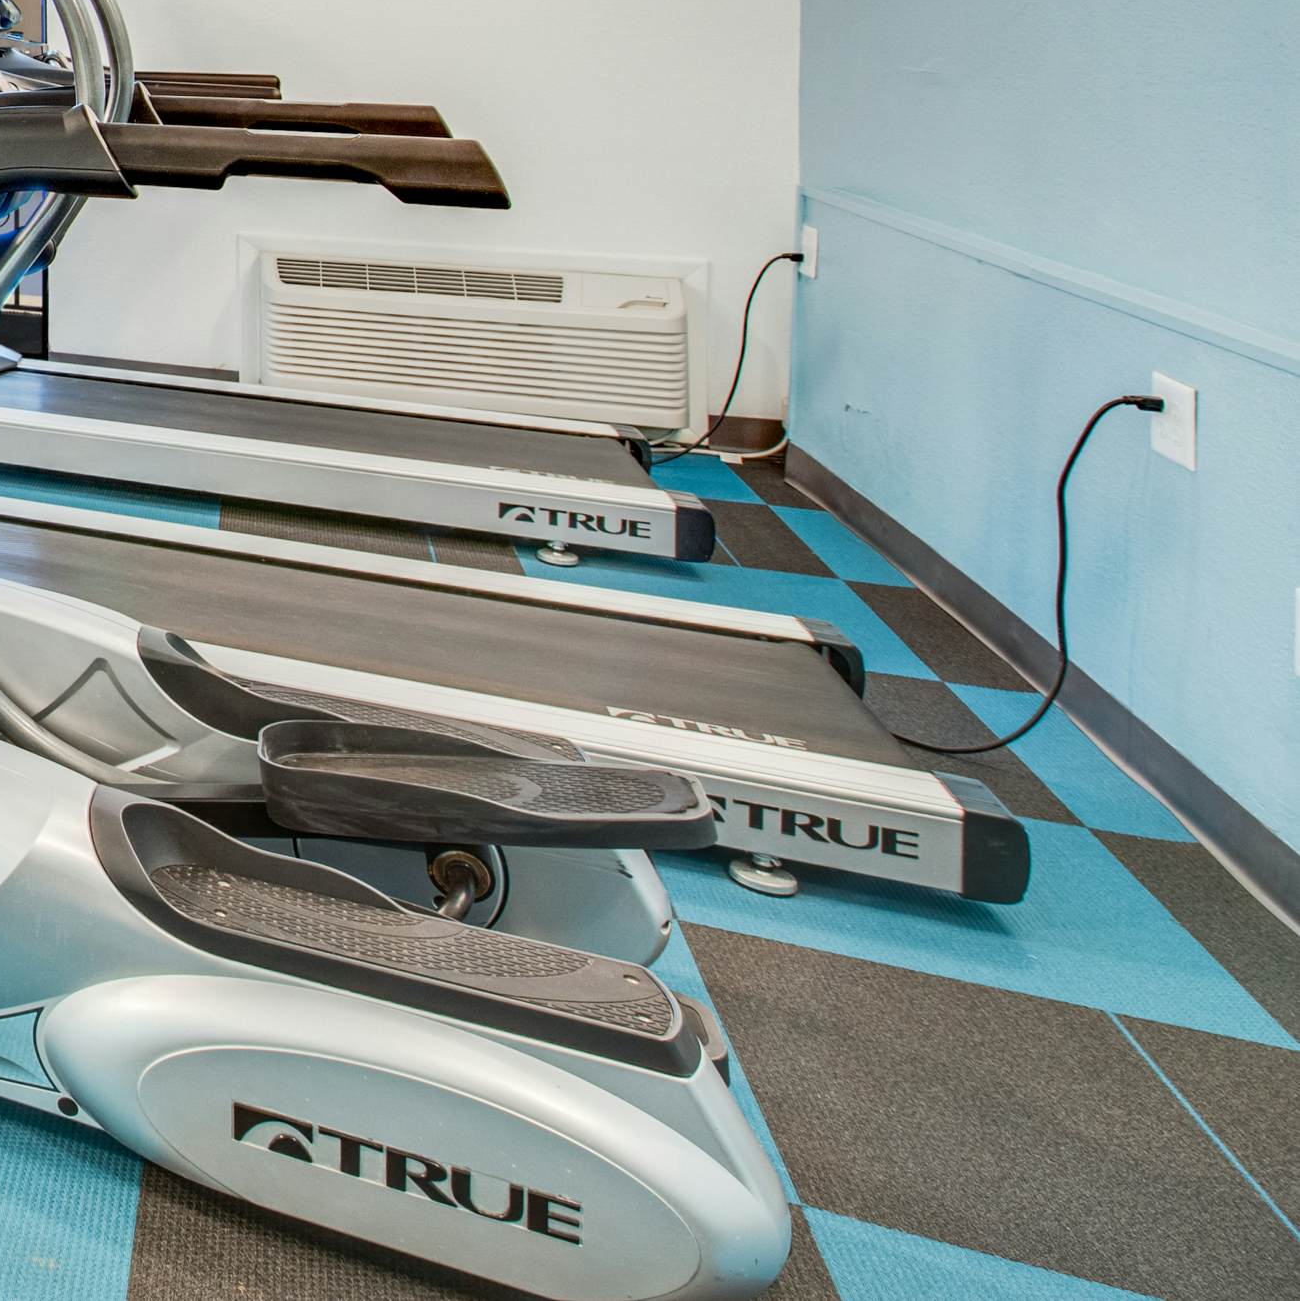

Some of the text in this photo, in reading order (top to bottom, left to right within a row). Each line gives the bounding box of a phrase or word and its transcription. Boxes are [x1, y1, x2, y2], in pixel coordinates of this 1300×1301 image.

[538, 507, 651, 539] TRUE
[657, 714, 808, 751] TRUE
[732, 798, 919, 860] TRUE
[317, 1124, 583, 1246] TRUE
